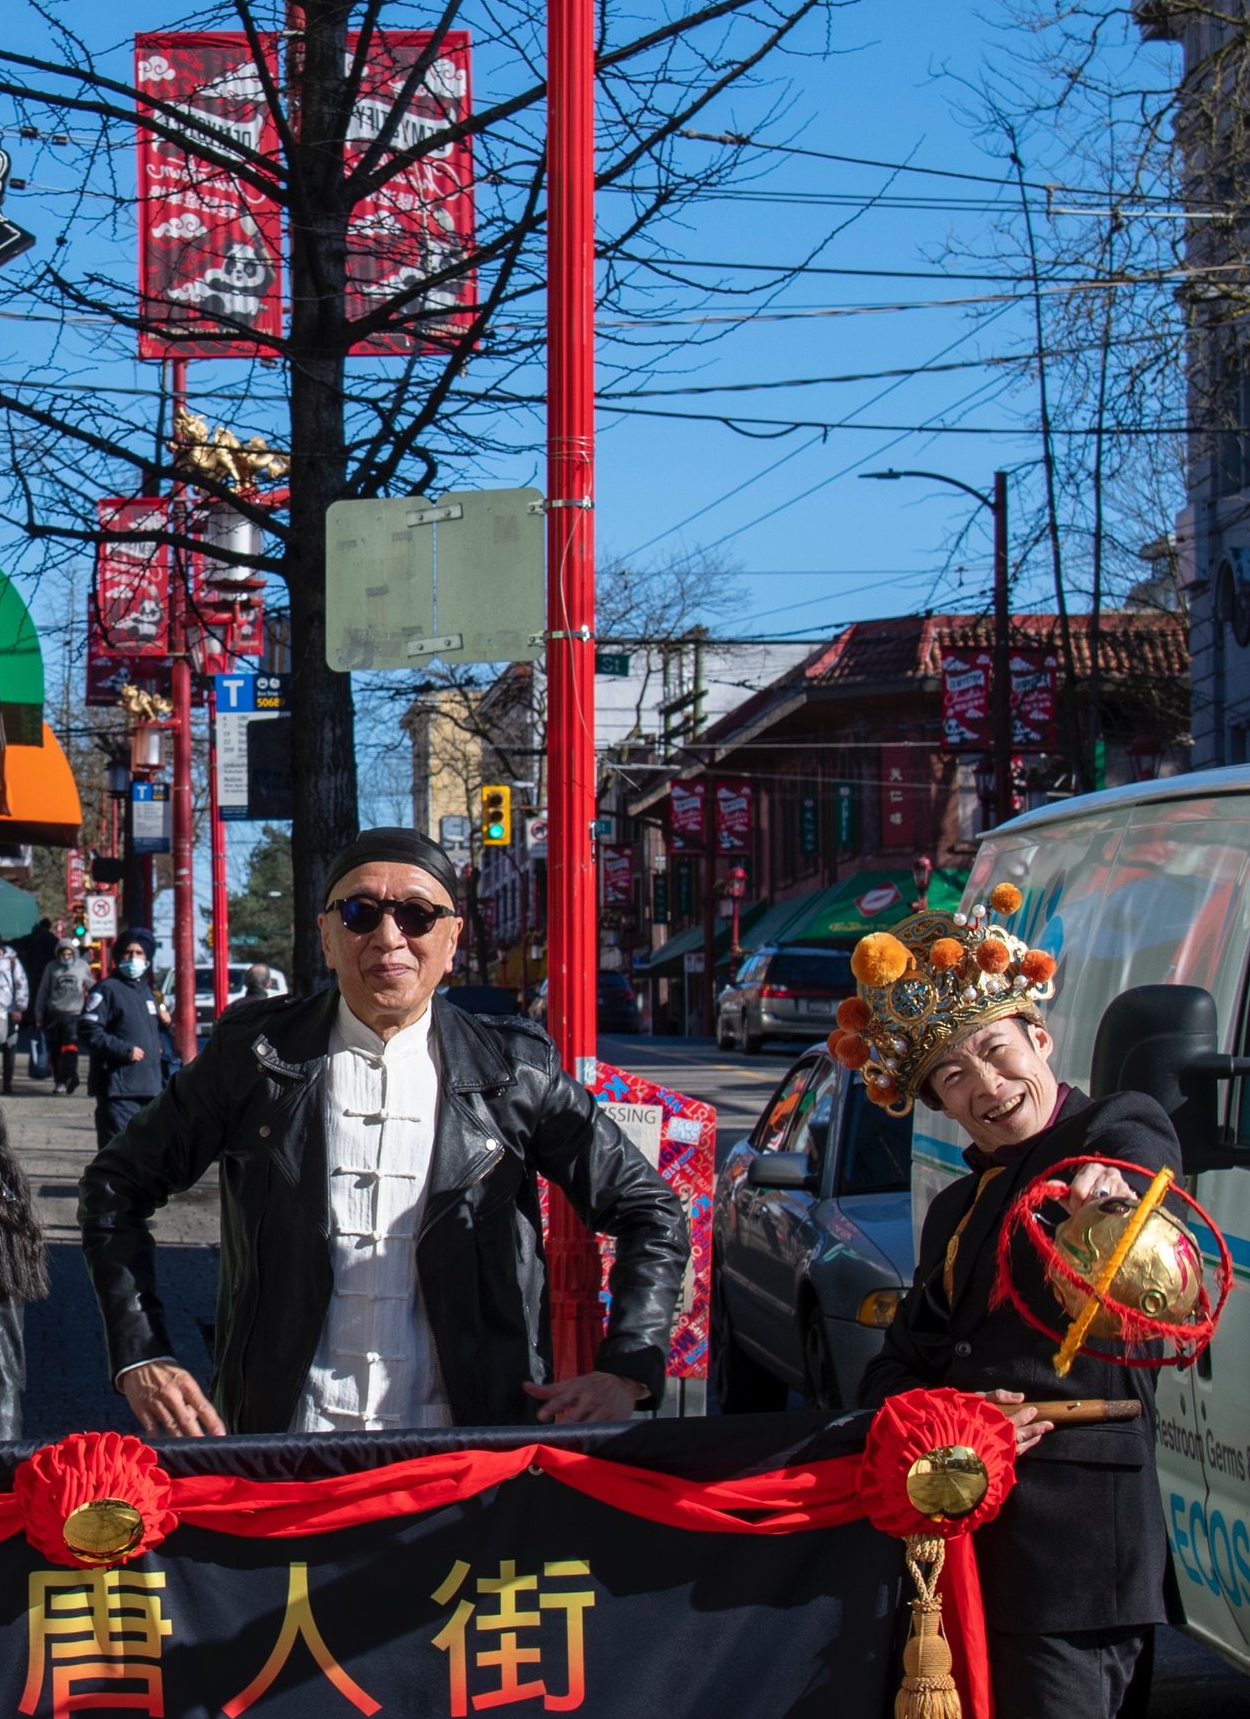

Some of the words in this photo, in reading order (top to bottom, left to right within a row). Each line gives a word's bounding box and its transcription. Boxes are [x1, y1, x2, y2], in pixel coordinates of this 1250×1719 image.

[222, 679, 244, 708] T
[604, 1106, 656, 1124] SSING
[1155, 1413, 1205, 1462] Restroom
[1205, 1428, 1246, 1482] Germs
[1169, 1492, 1250, 1608] ECOS
